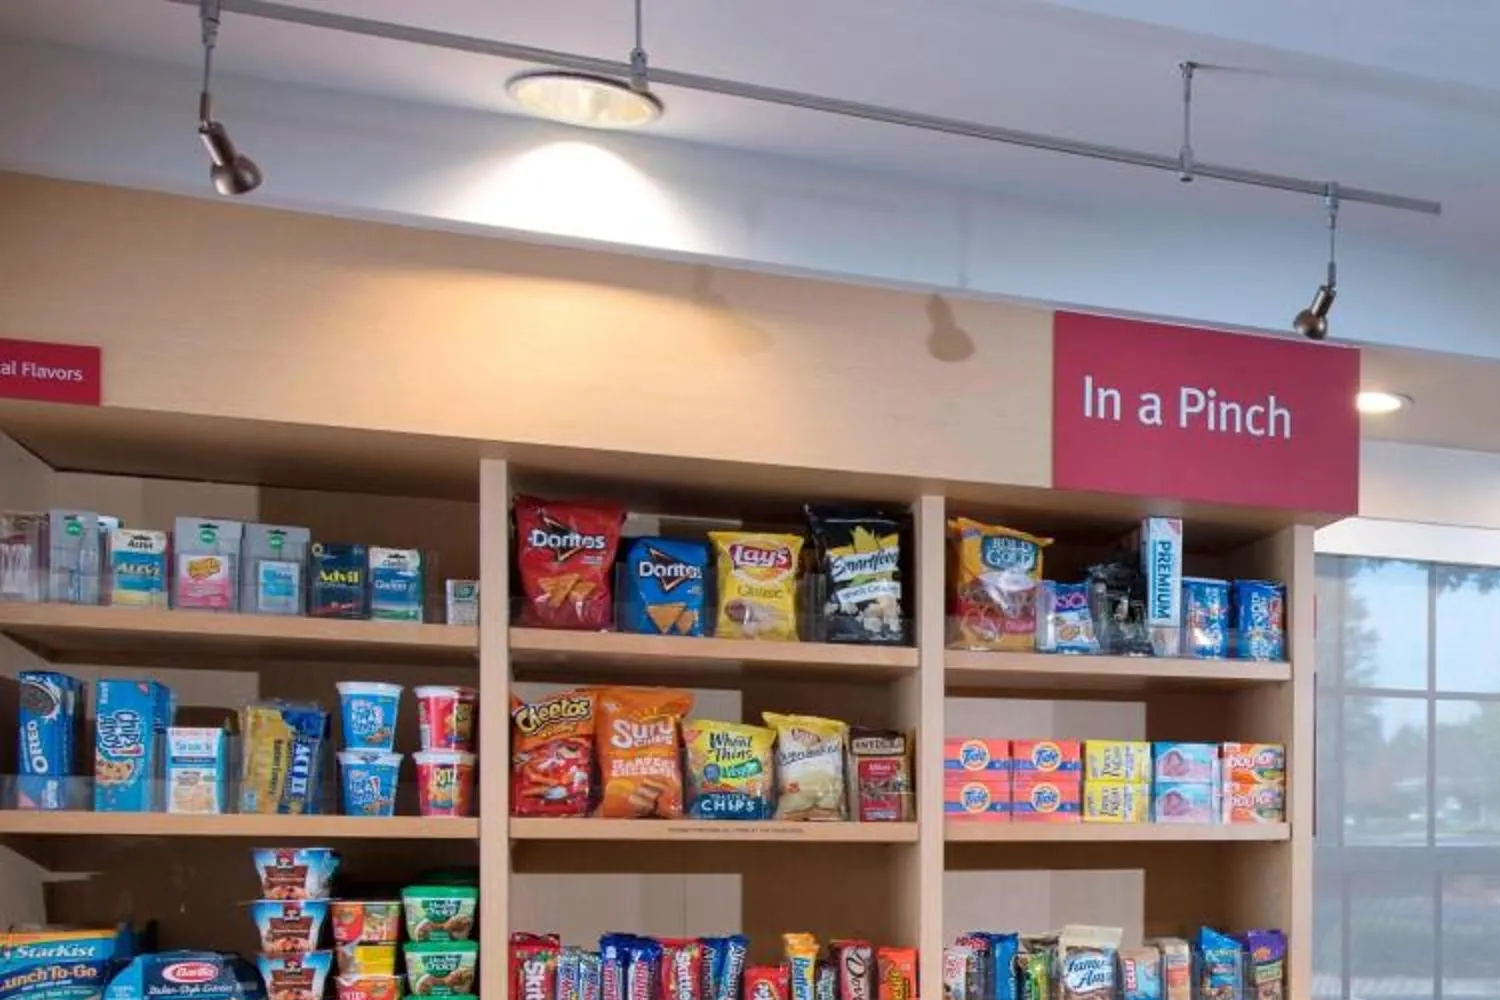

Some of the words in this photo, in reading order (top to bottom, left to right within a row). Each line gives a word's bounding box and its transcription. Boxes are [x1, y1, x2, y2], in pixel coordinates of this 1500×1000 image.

[21, 362, 83, 381] Flavors
[1083, 375, 1121, 420] In
[1138, 393, 1162, 426] a
[1179, 386, 1291, 439] Pinch
[531, 529, 606, 549] Doritos
[733, 546, 791, 566] Lay's
[320, 570, 360, 584] Advil
[639, 561, 702, 579] Doritos
[1158, 540, 1172, 619] PREMIUM
[515, 700, 591, 732] Cheetos
[27, 720, 49, 774] OREO
[701, 799, 755, 812] CHIPS
[17, 944, 95, 957] StarKist
